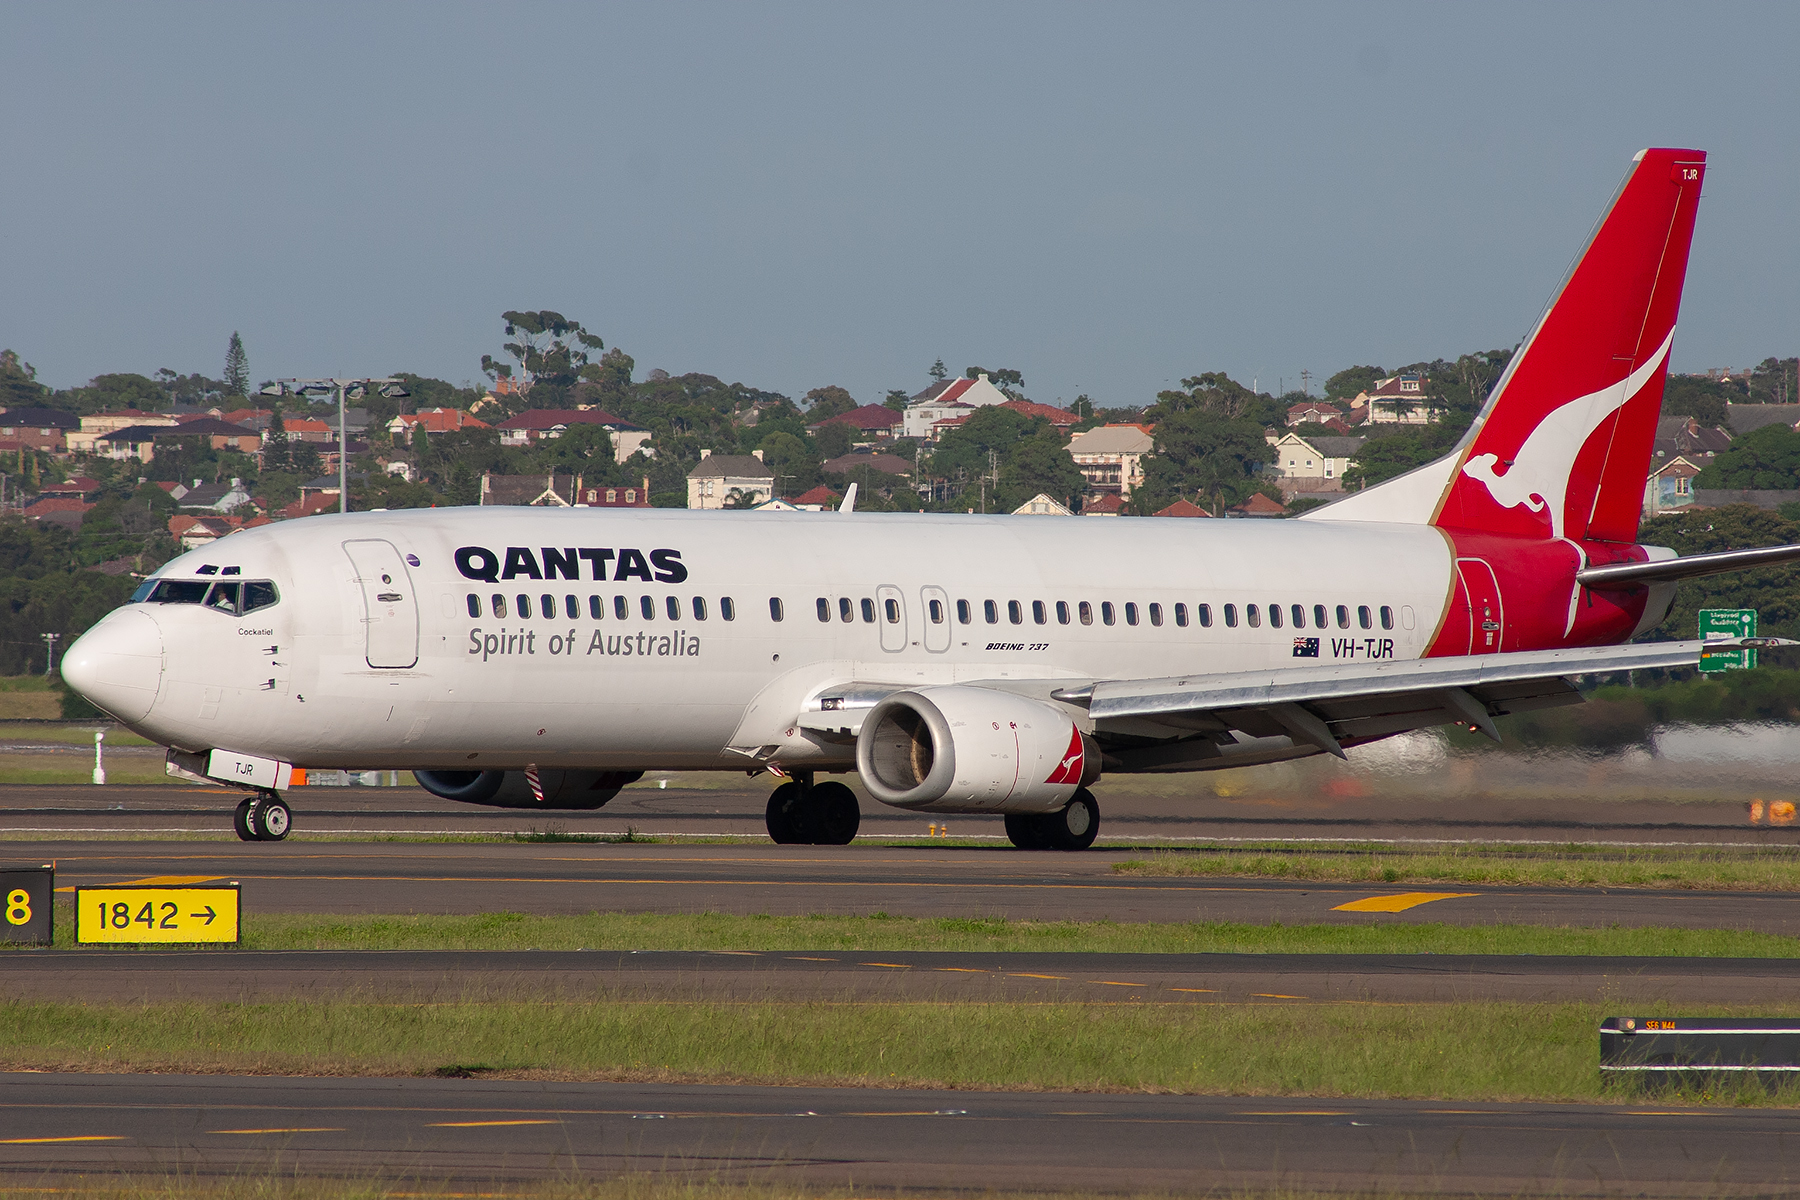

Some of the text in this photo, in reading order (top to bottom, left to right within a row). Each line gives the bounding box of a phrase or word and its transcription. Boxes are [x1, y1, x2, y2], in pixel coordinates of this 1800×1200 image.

[1683, 169, 1698, 180] TJR
[454, 546, 688, 584] QANTAS
[238, 627, 273, 636] Cockatiel
[469, 627, 700, 662] Spirit of Australia
[985, 642, 1049, 651] BOEING 737
[1331, 638, 1394, 659] VH-TJR
[235, 762, 254, 776] TJR
[5, 888, 32, 926] 8
[98, 901, 179, 930] 1842
